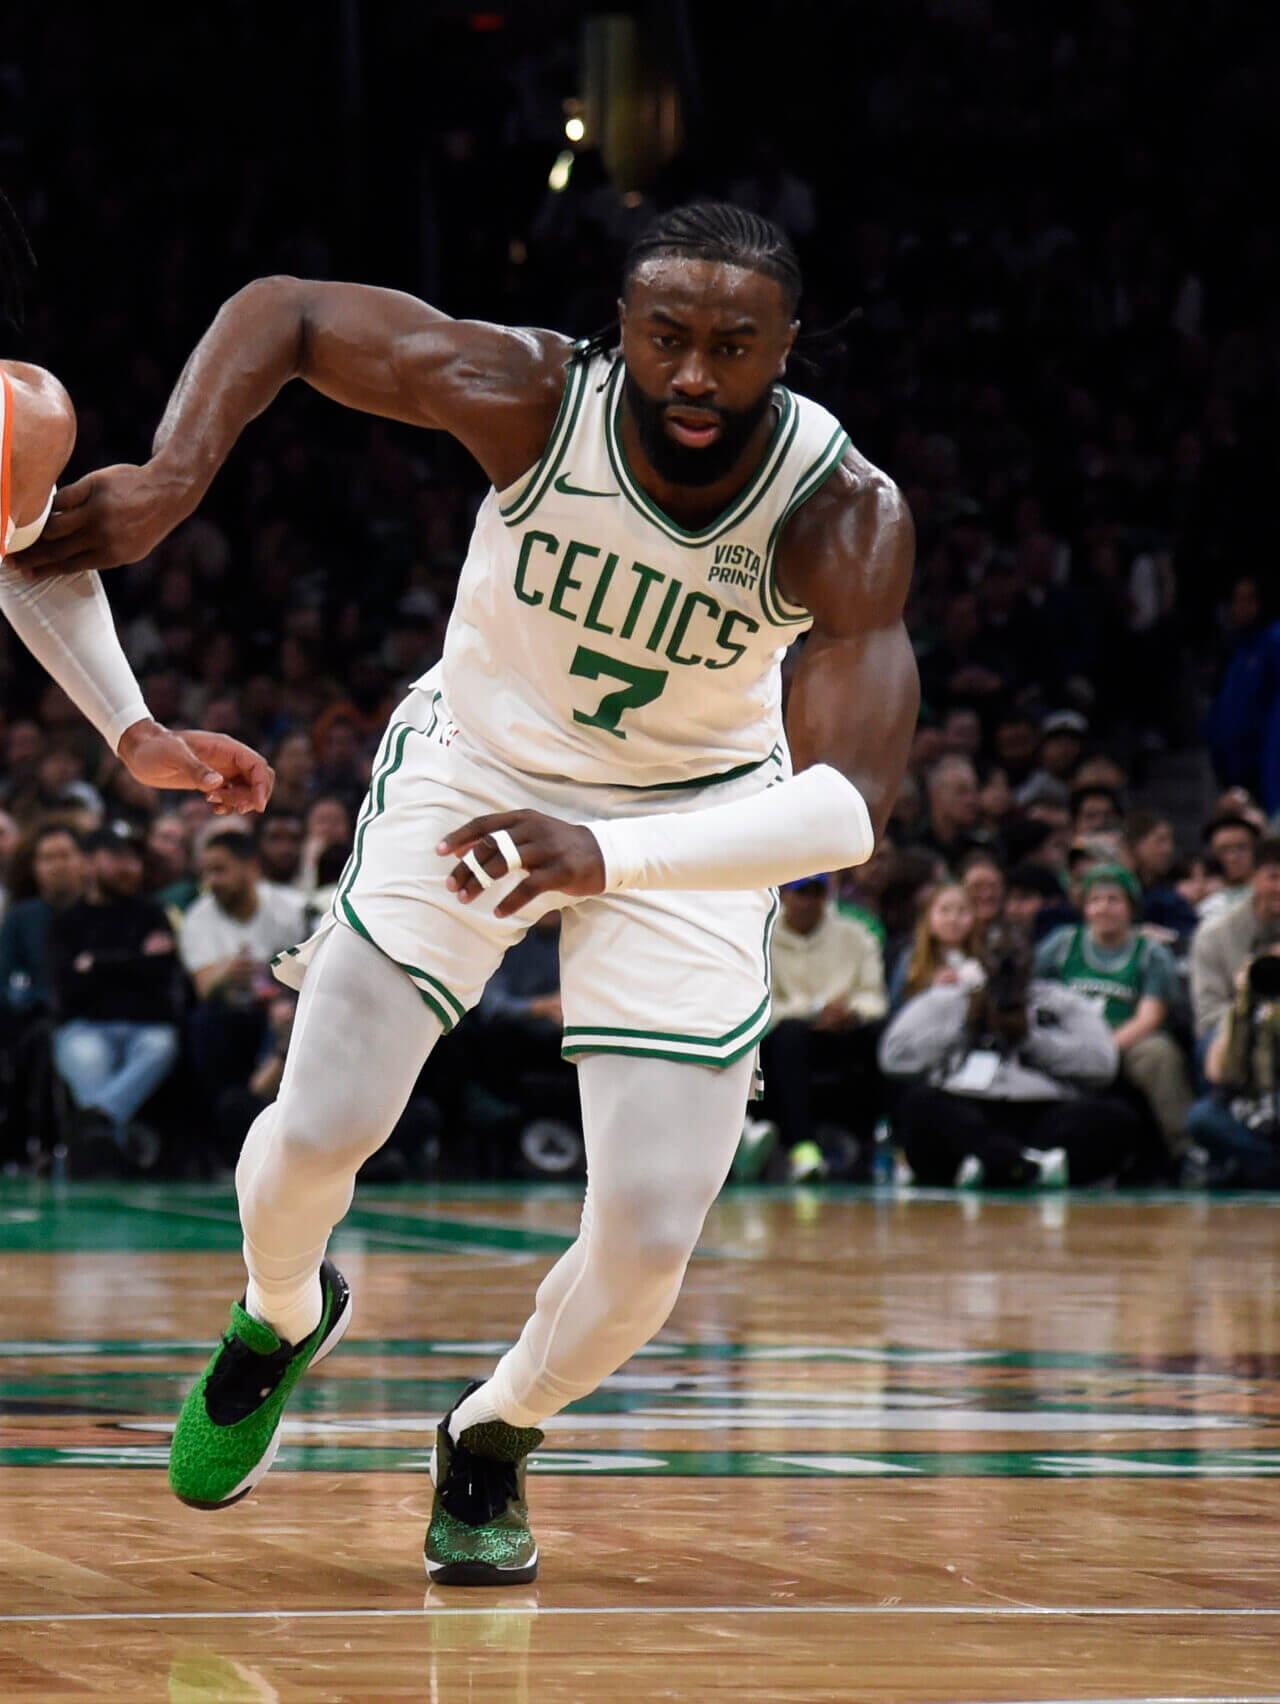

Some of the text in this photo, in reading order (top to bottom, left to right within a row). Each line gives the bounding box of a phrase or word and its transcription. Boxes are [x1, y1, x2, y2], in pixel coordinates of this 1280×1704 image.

[707, 566, 758, 591] PRINT
[713, 545, 760, 577] VISTA
[513, 530, 760, 670] CELTICS
[569, 645, 669, 740] 7
